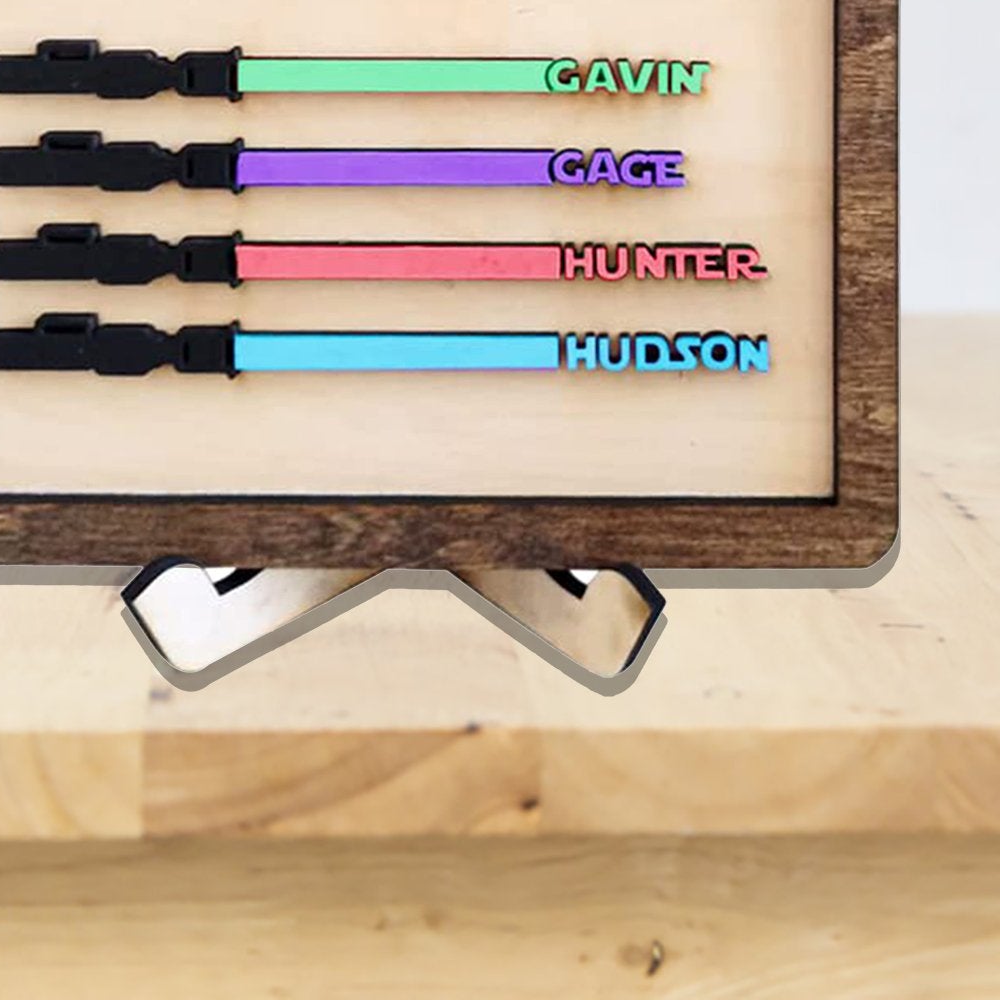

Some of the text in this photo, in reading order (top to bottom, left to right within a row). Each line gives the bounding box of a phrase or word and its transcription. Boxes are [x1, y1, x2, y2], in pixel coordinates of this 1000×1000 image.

[546, 59, 710, 95] GAVIN
[551, 149, 686, 187] GAGE
[564, 243, 768, 281] HUNTER
[565, 331, 769, 372] HUDSON
